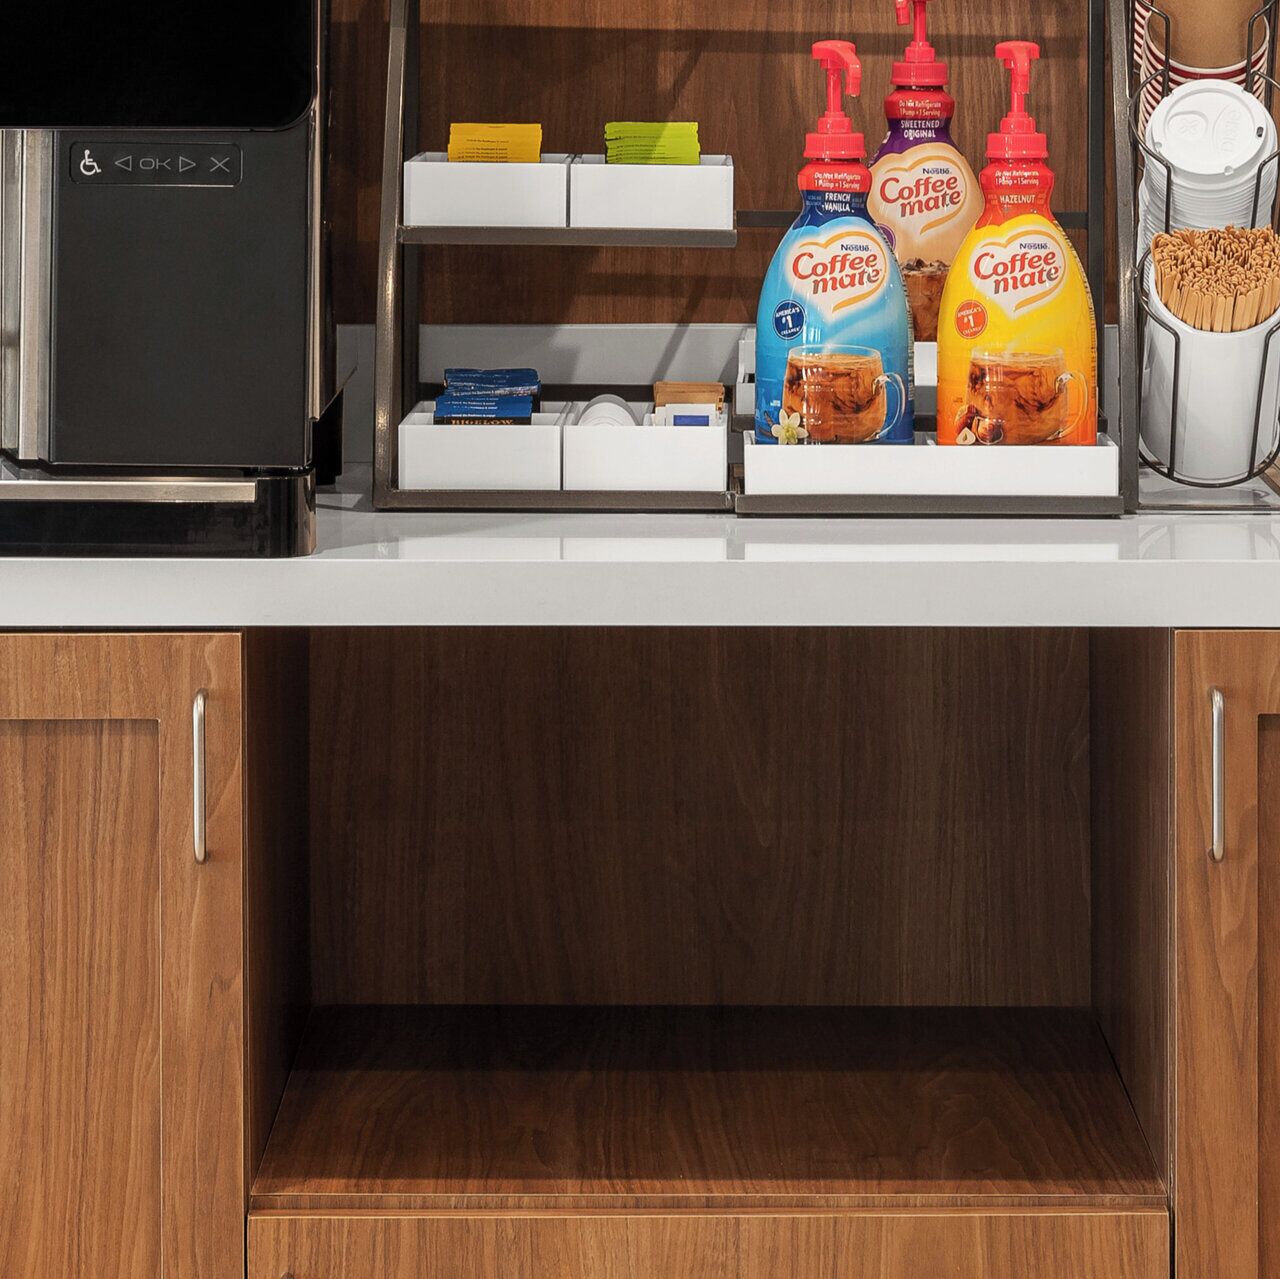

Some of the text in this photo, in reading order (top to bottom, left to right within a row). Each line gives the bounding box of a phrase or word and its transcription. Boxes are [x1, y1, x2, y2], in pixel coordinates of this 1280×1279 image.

[922, 109, 940, 117] Serving
[901, 119, 940, 128] SWEETENED
[903, 129, 936, 138] ORIGINAL
[139, 157, 171, 170] OK
[843, 181, 860, 190] Serving
[1021, 178, 1039, 186] Serving
[880, 175, 958, 204] Coffee
[825, 193, 851, 202] FRENCH
[1000, 195, 1035, 204] HAZELNUT
[824, 202, 851, 212] VANILLA
[900, 190, 961, 218] mate
[792, 252, 878, 280] Coffee
[974, 251, 1056, 280] Coffee
[812, 268, 880, 294] mate
[994, 266, 1059, 294] mate
[775, 307, 800, 318] AMERICA'S
